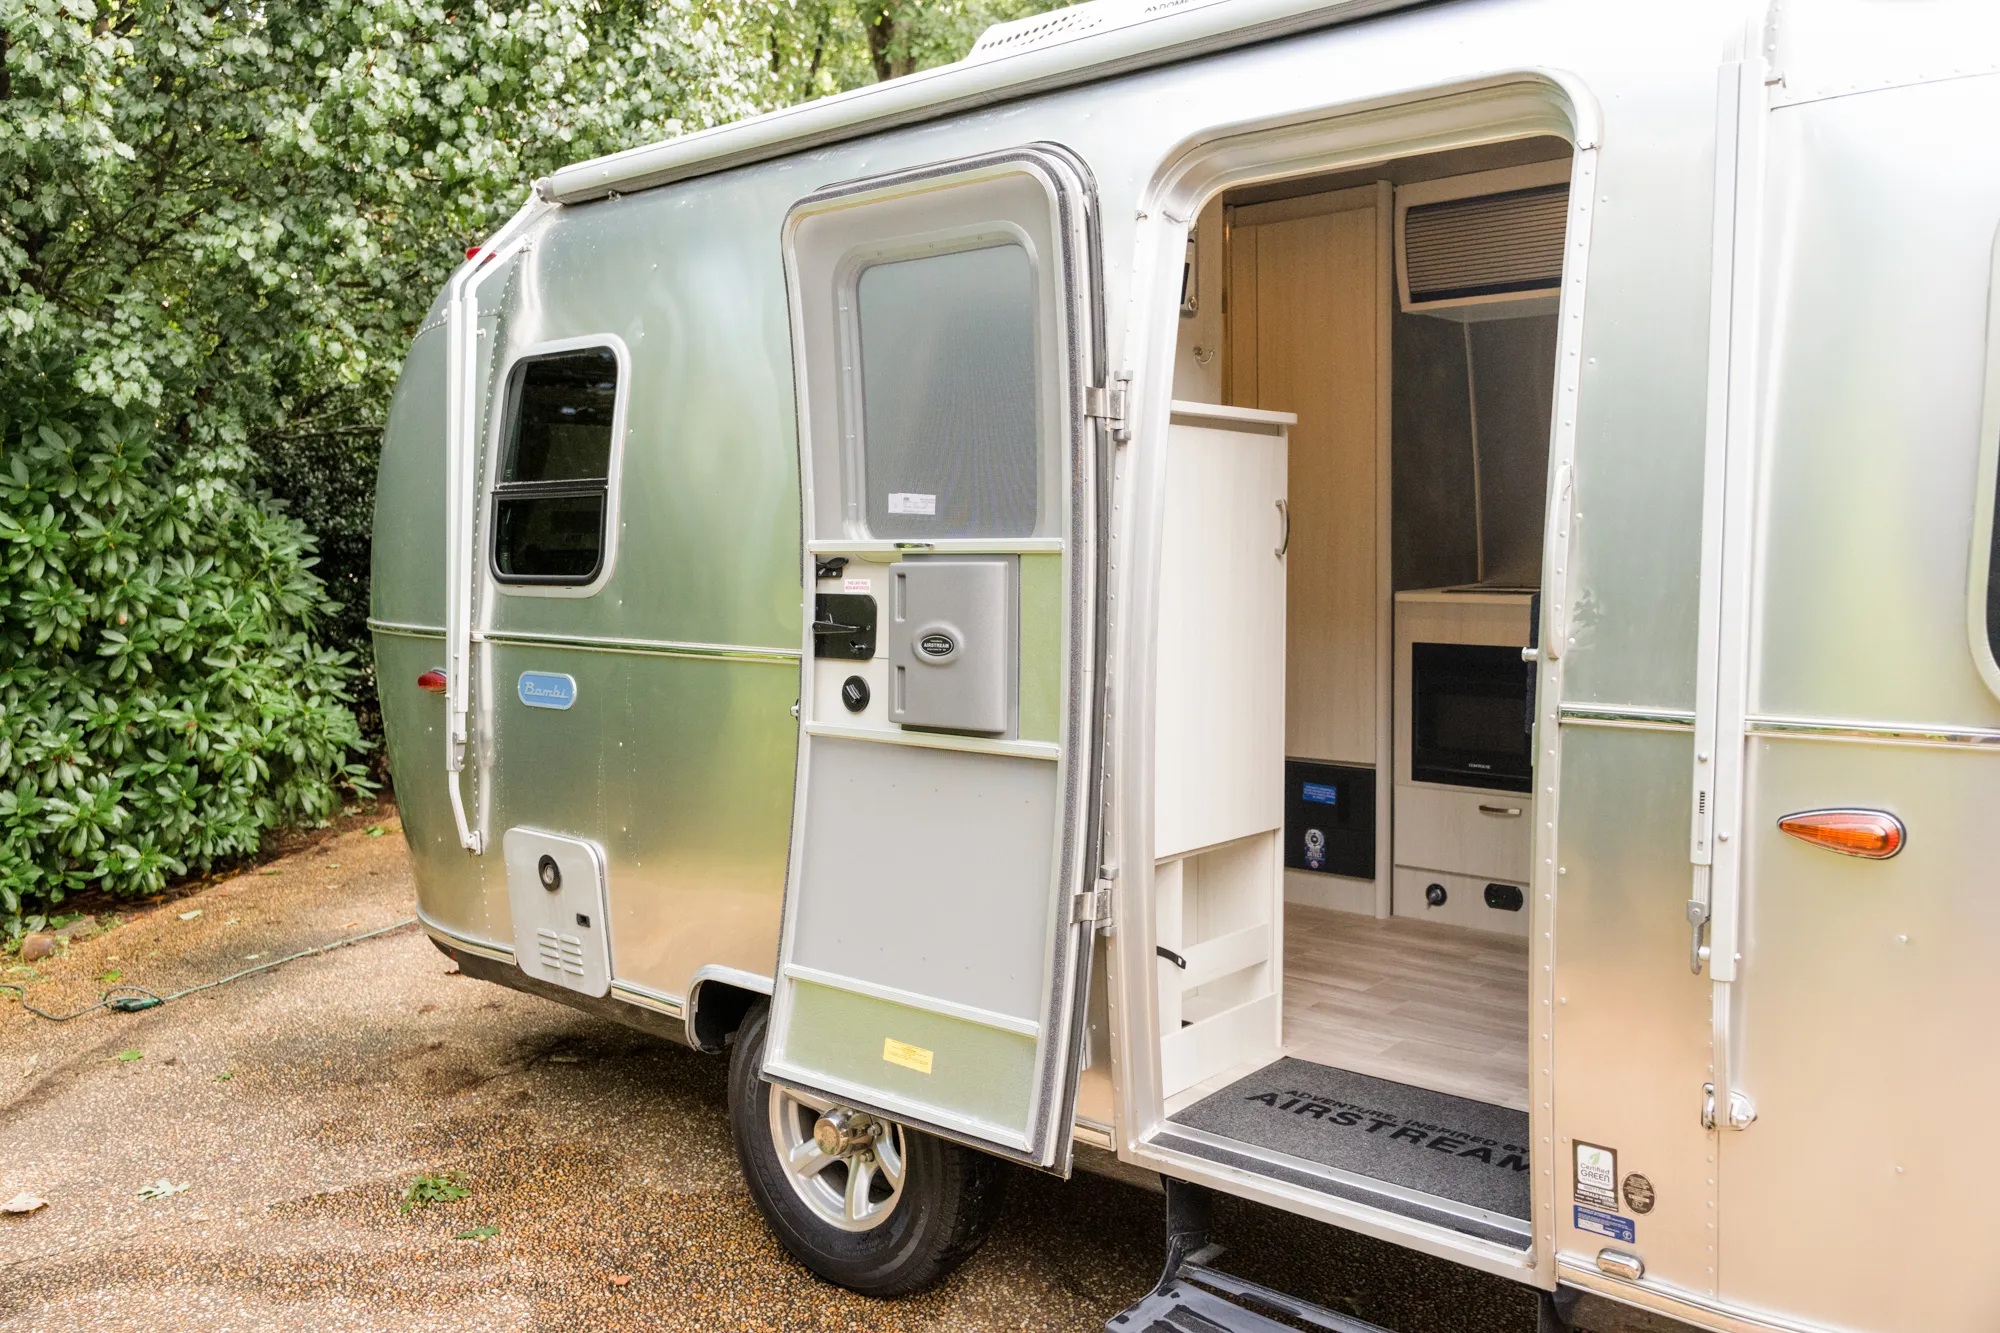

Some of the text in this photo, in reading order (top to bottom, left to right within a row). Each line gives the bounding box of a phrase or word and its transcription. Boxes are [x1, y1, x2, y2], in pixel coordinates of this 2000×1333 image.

[524, 681, 569, 698] Bambi
[1404, 1119, 1498, 1146] INSPIRED
[1580, 1162, 1610, 1175] Certified
[1580, 1169, 1610, 1183] GREEN
